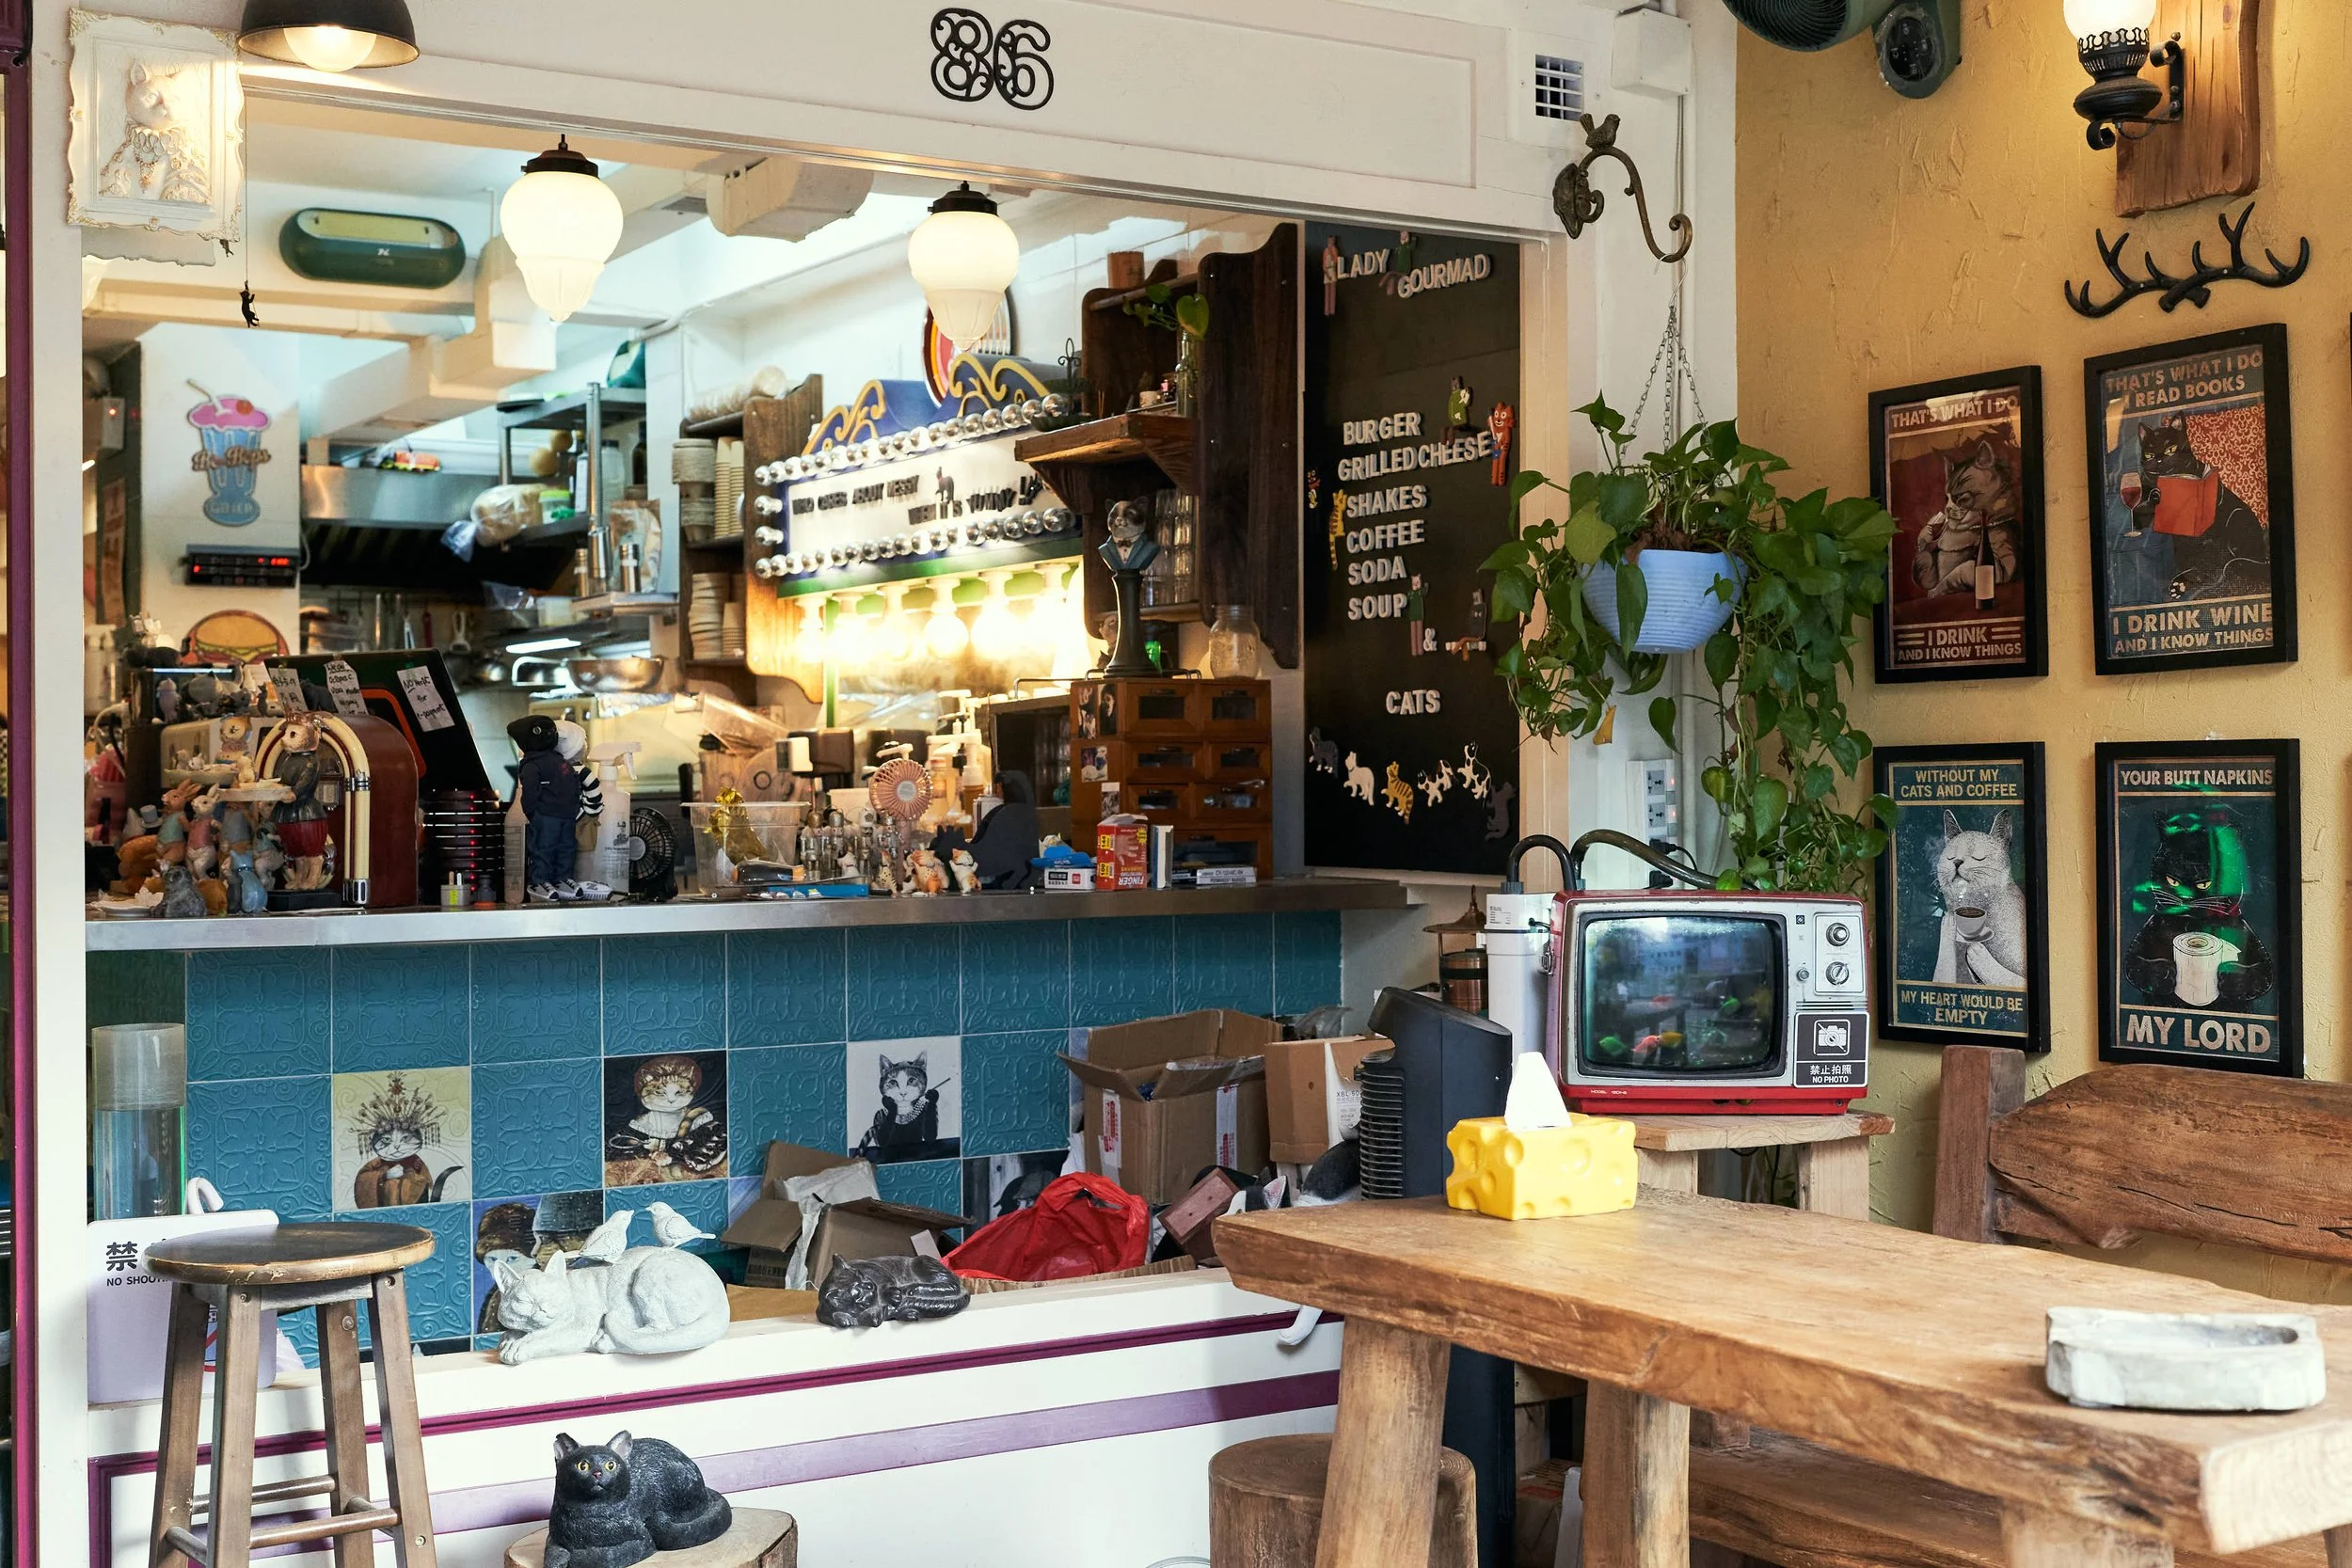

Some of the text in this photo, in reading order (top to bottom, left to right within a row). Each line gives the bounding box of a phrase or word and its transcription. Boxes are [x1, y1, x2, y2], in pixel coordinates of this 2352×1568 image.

[930, 8, 1054, 110] 86
[1337, 248, 1490, 298] LADY GOURMAD
[2106, 351, 2264, 392] THAT'S WHAT I DO
[2136, 387, 2181, 407] READ
[2185, 374, 2246, 400] BOOKS
[1892, 395, 2018, 428] THAT'S WHAT I DO
[1343, 412, 1422, 445] BURGER
[1338, 431, 1493, 482] GRILLED CHEESE
[852, 483, 884, 505] ABOUT
[1346, 484, 1427, 517] SHAKES
[1346, 519, 1425, 553] COFFEE
[1348, 556, 1407, 586] SODA
[1348, 593, 1407, 620] SOUP
[2113, 603, 2273, 635] I DRINK WINE
[1929, 626, 1987, 645] I DRINK
[2115, 627, 2273, 653] AND I KNOW THINGS
[1898, 641, 2022, 661] AND I KNOW THINGS
[403, 679, 414, 689] NO
[1386, 689, 1441, 715] CATS
[1915, 768, 1999, 783] WITHOUT MY
[2121, 768, 2273, 785] YOUR BUTT NAPKINS
[1900, 784, 2017, 798] CATS AND COFFEE
[1901, 990, 2023, 1011] MY HEART WOULD BE
[1935, 1007, 1988, 1025] EMPTY
[2126, 1014, 2271, 1054] MY LORD
[1810, 1065, 1851, 1075] 禁止拍照
[107, 1277, 122, 1286] NO
